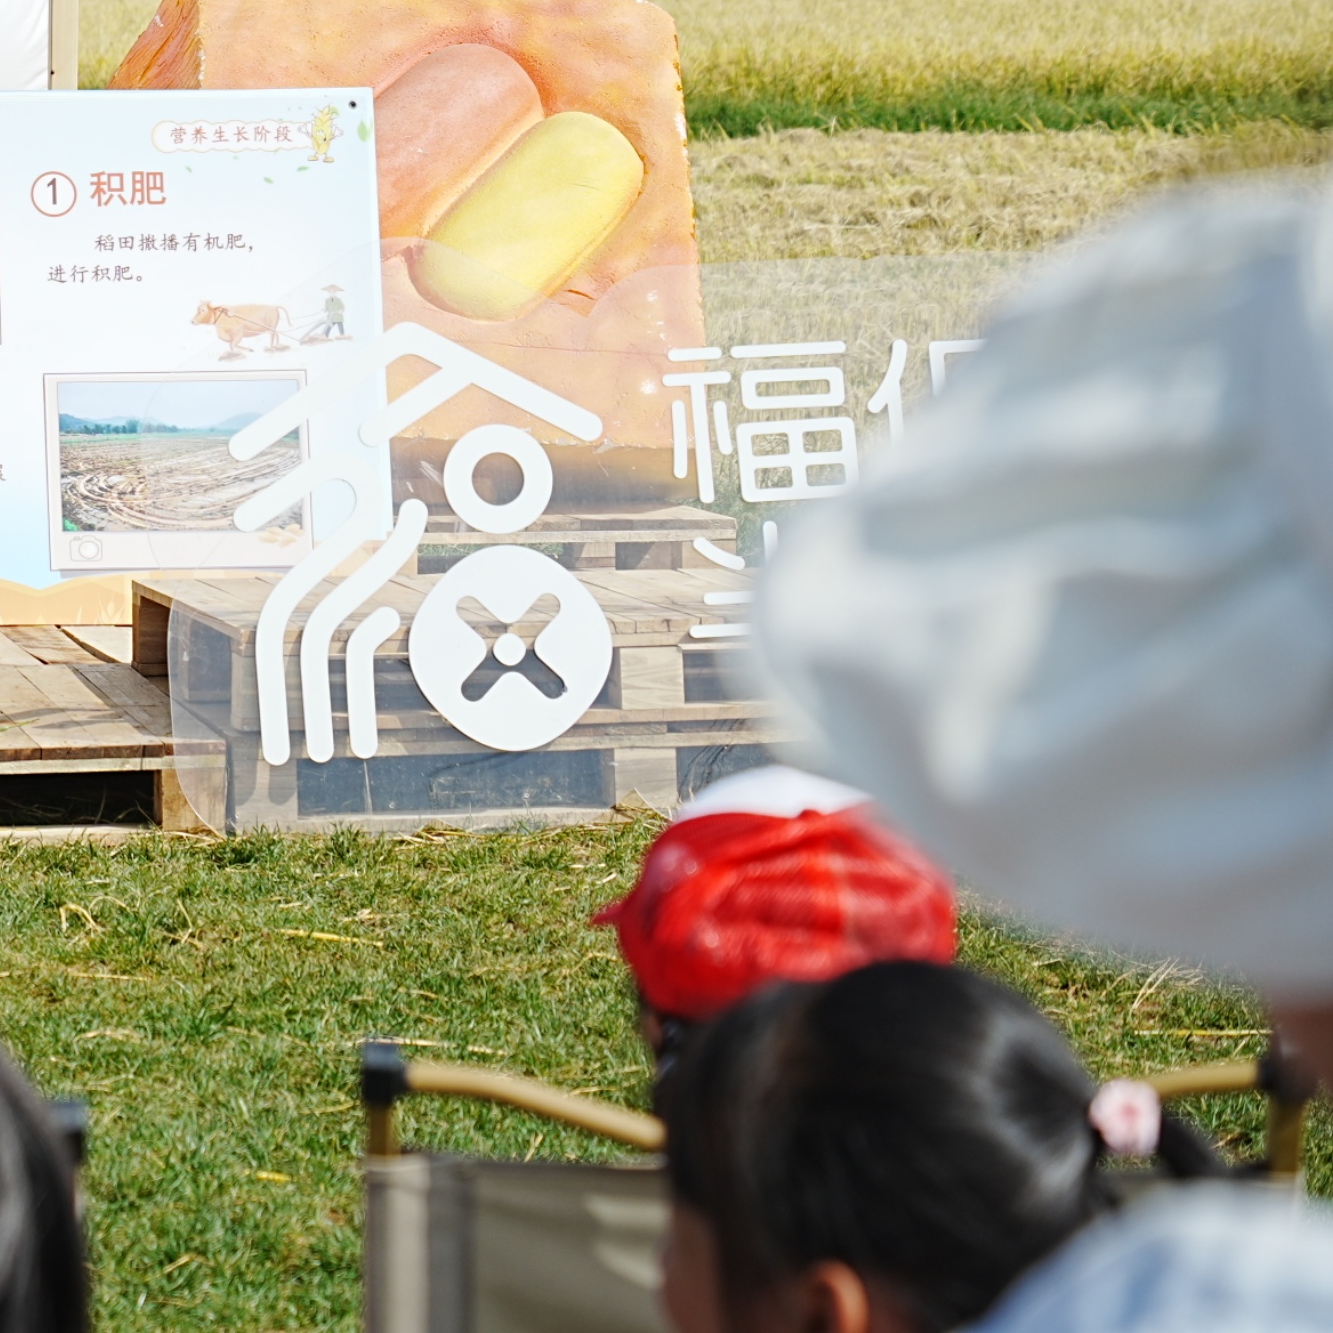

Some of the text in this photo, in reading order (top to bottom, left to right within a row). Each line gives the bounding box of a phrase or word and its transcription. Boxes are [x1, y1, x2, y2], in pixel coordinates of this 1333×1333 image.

[170, 125, 294, 145] 营养生长阶段
[89, 170, 167, 208] 积肥
[47, 264, 144, 284] 进行积肥。
